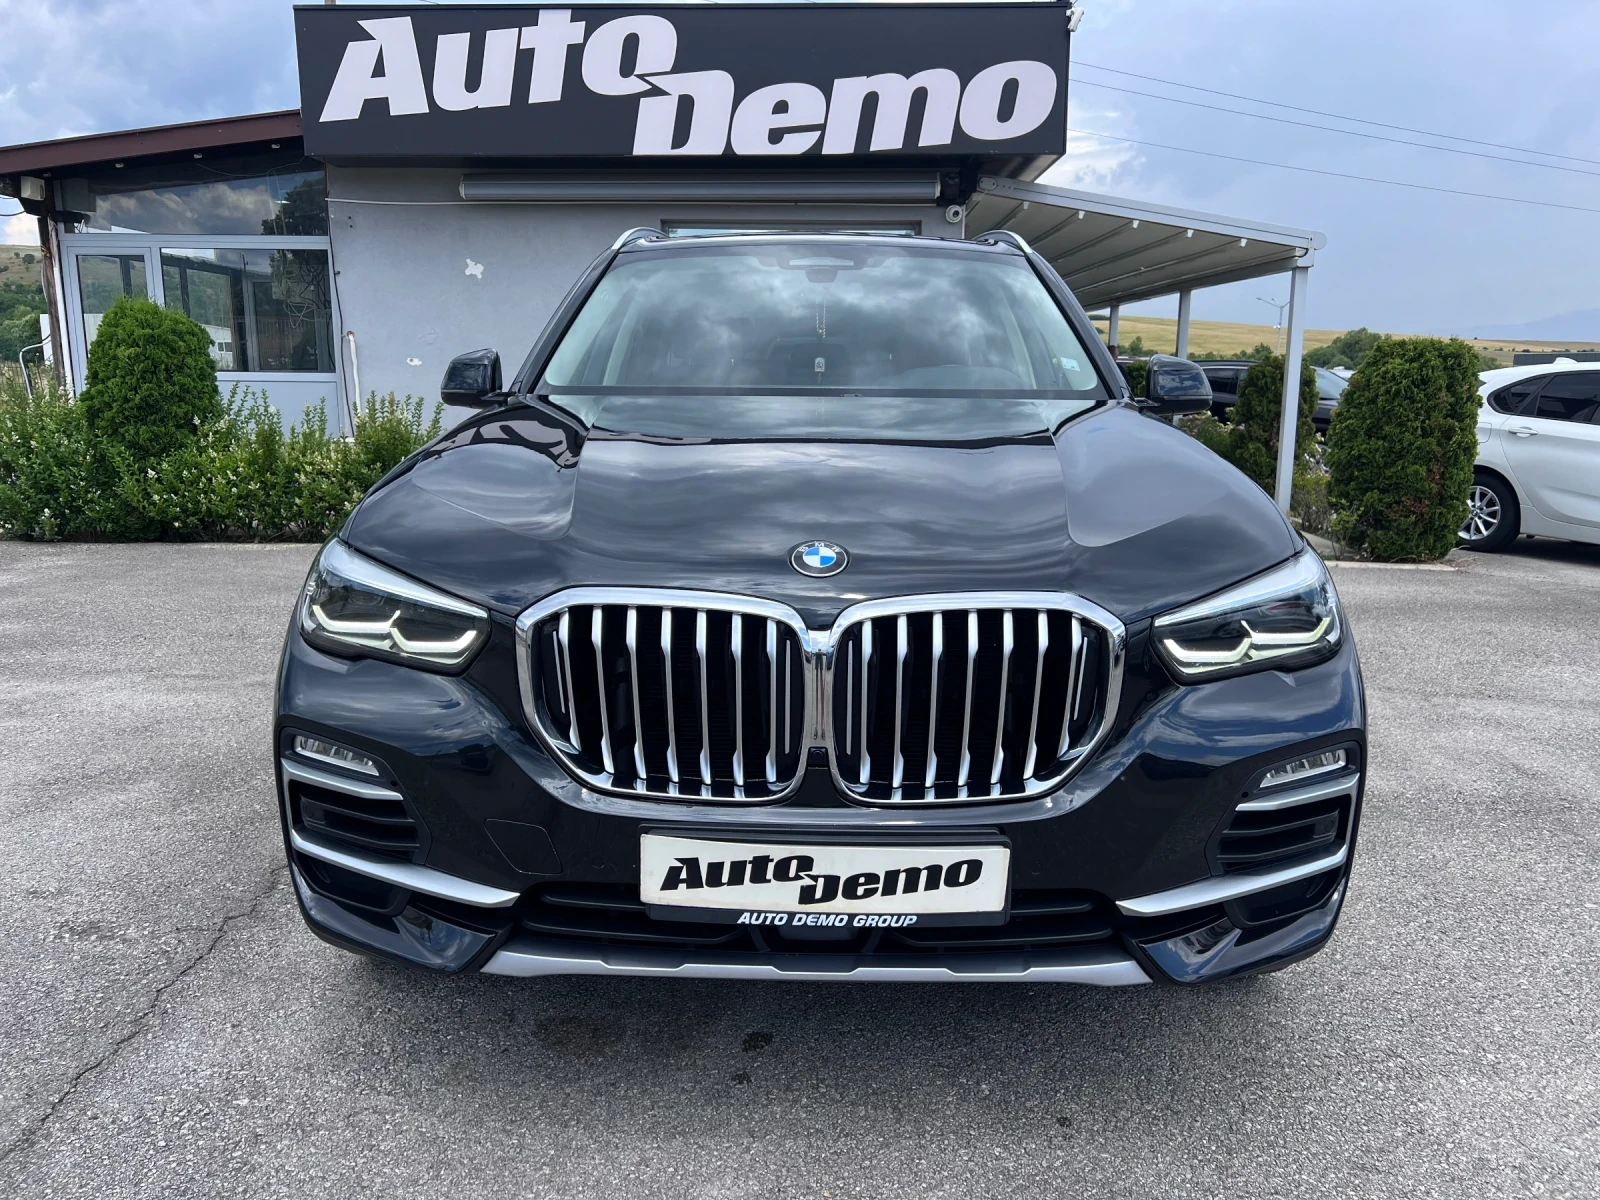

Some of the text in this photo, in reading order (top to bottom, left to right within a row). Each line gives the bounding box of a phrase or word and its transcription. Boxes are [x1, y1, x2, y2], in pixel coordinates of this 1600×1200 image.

[319, 9, 677, 122] Auto
[634, 60, 1057, 155] Demo
[660, 855, 814, 890] Auto
[798, 859, 983, 905] Demo
[737, 912, 917, 927] AUTO DEMO GROUP
